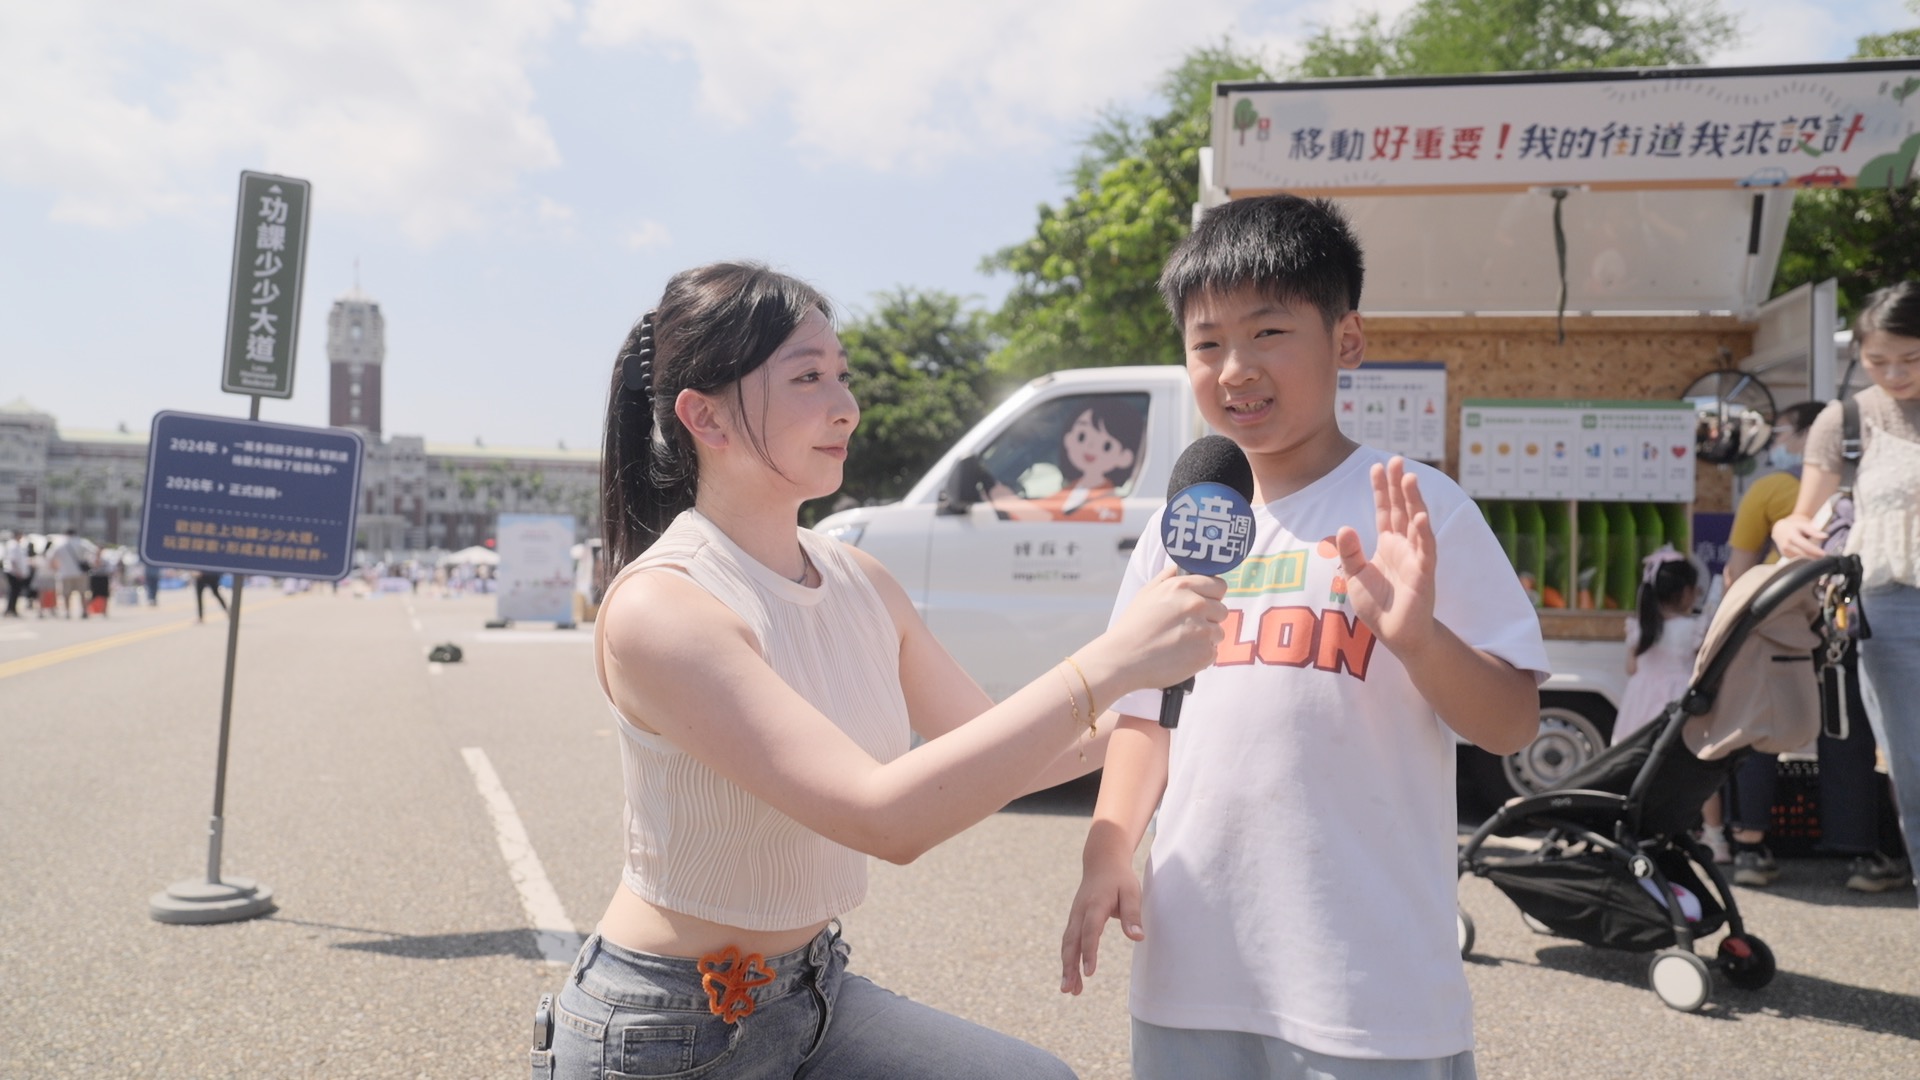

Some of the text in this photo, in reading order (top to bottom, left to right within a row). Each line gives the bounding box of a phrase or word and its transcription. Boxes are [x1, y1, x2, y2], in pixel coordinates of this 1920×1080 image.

[245, 196, 289, 363] 功課少少大道
[170, 437, 218, 456] 2024年
[166, 476, 214, 493] 2026年
